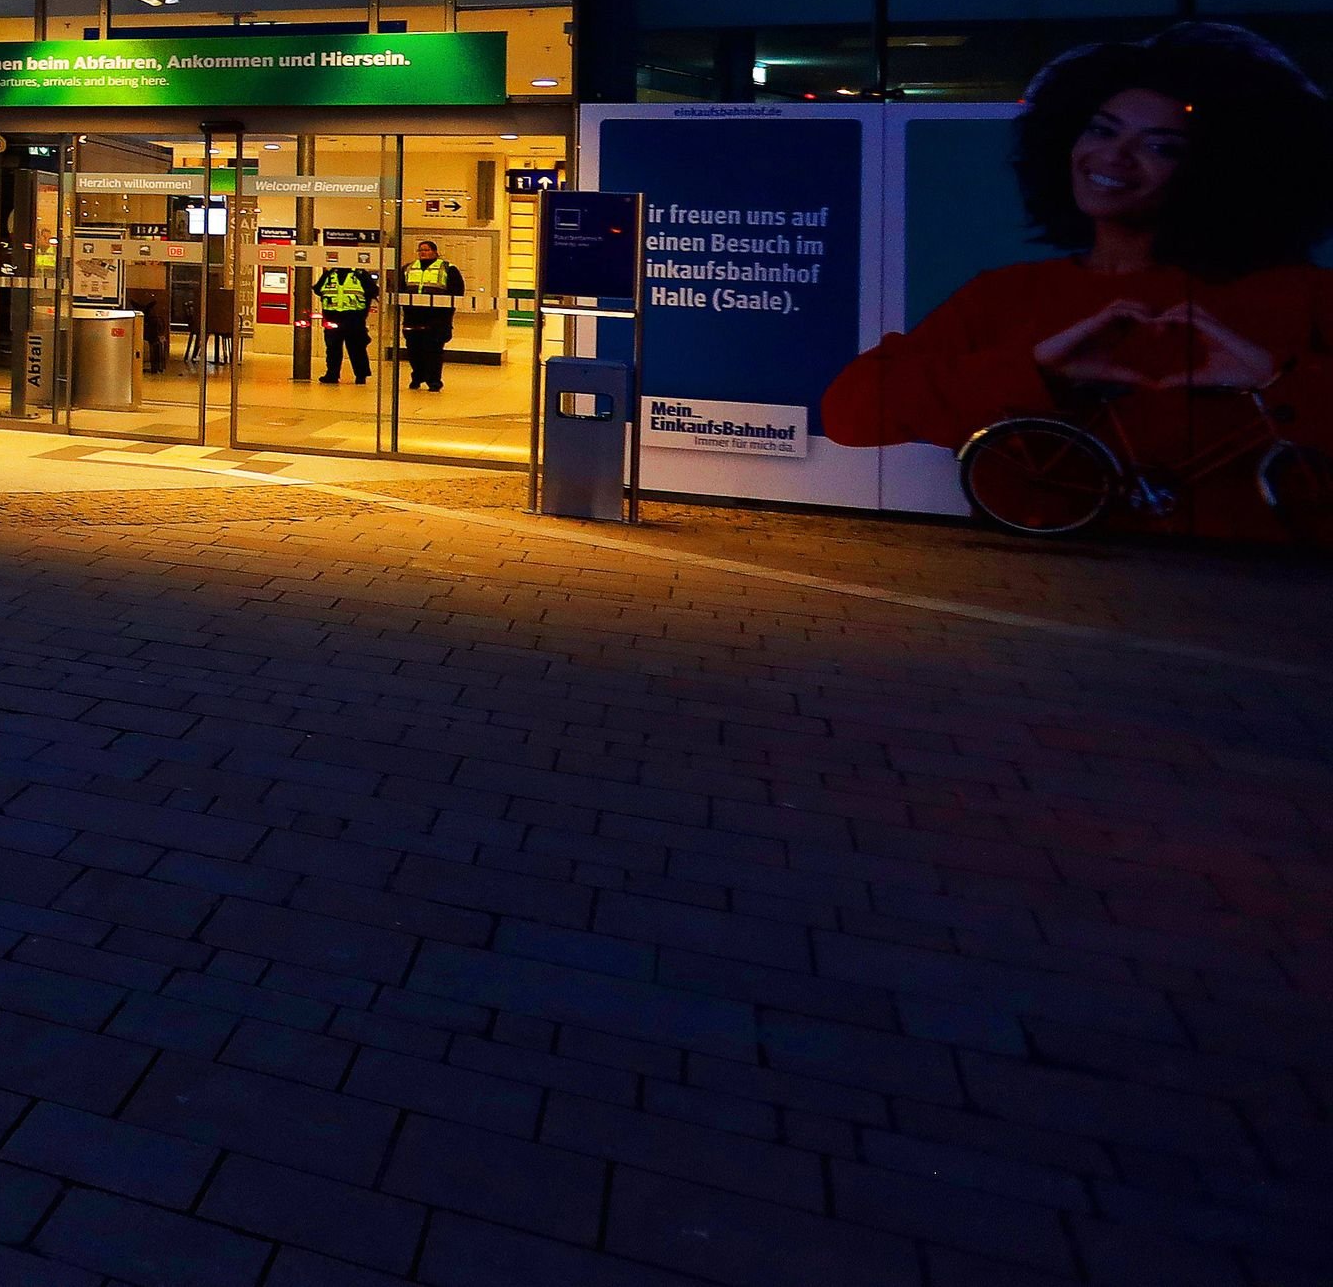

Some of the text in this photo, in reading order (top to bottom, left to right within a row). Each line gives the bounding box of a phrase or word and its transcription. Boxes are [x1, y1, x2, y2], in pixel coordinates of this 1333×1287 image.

[26, 57, 69, 70] beim
[73, 56, 162, 71] Abfahren,
[167, 54, 274, 69] Ankommen
[279, 53, 315, 67] und
[320, 51, 411, 67] Hiersein.
[43, 76, 81, 87] arrivals
[84, 76, 105, 86] and
[108, 76, 138, 88] being
[140, 75, 170, 86] here.
[674, 107, 782, 117] einkaufsbahnhof.de
[79, 178, 191, 190] Herzlich willkommen!
[255, 180, 378, 193] Welcome! Bienvenue!
[648, 204, 829, 227] ir freuen uns auf
[170, 248, 183, 256] DB
[711, 234, 790, 254] Besuch
[796, 236, 824, 255] im
[260, 250, 275, 258] DB
[646, 259, 820, 283] inkaufsbahnhof
[651, 287, 800, 314] Halle (Saale).
[28, 335, 42, 388] Abfall
[650, 416, 795, 440] EinkaufsBahnhof
[694, 436, 795, 453] Immer für mich da.
